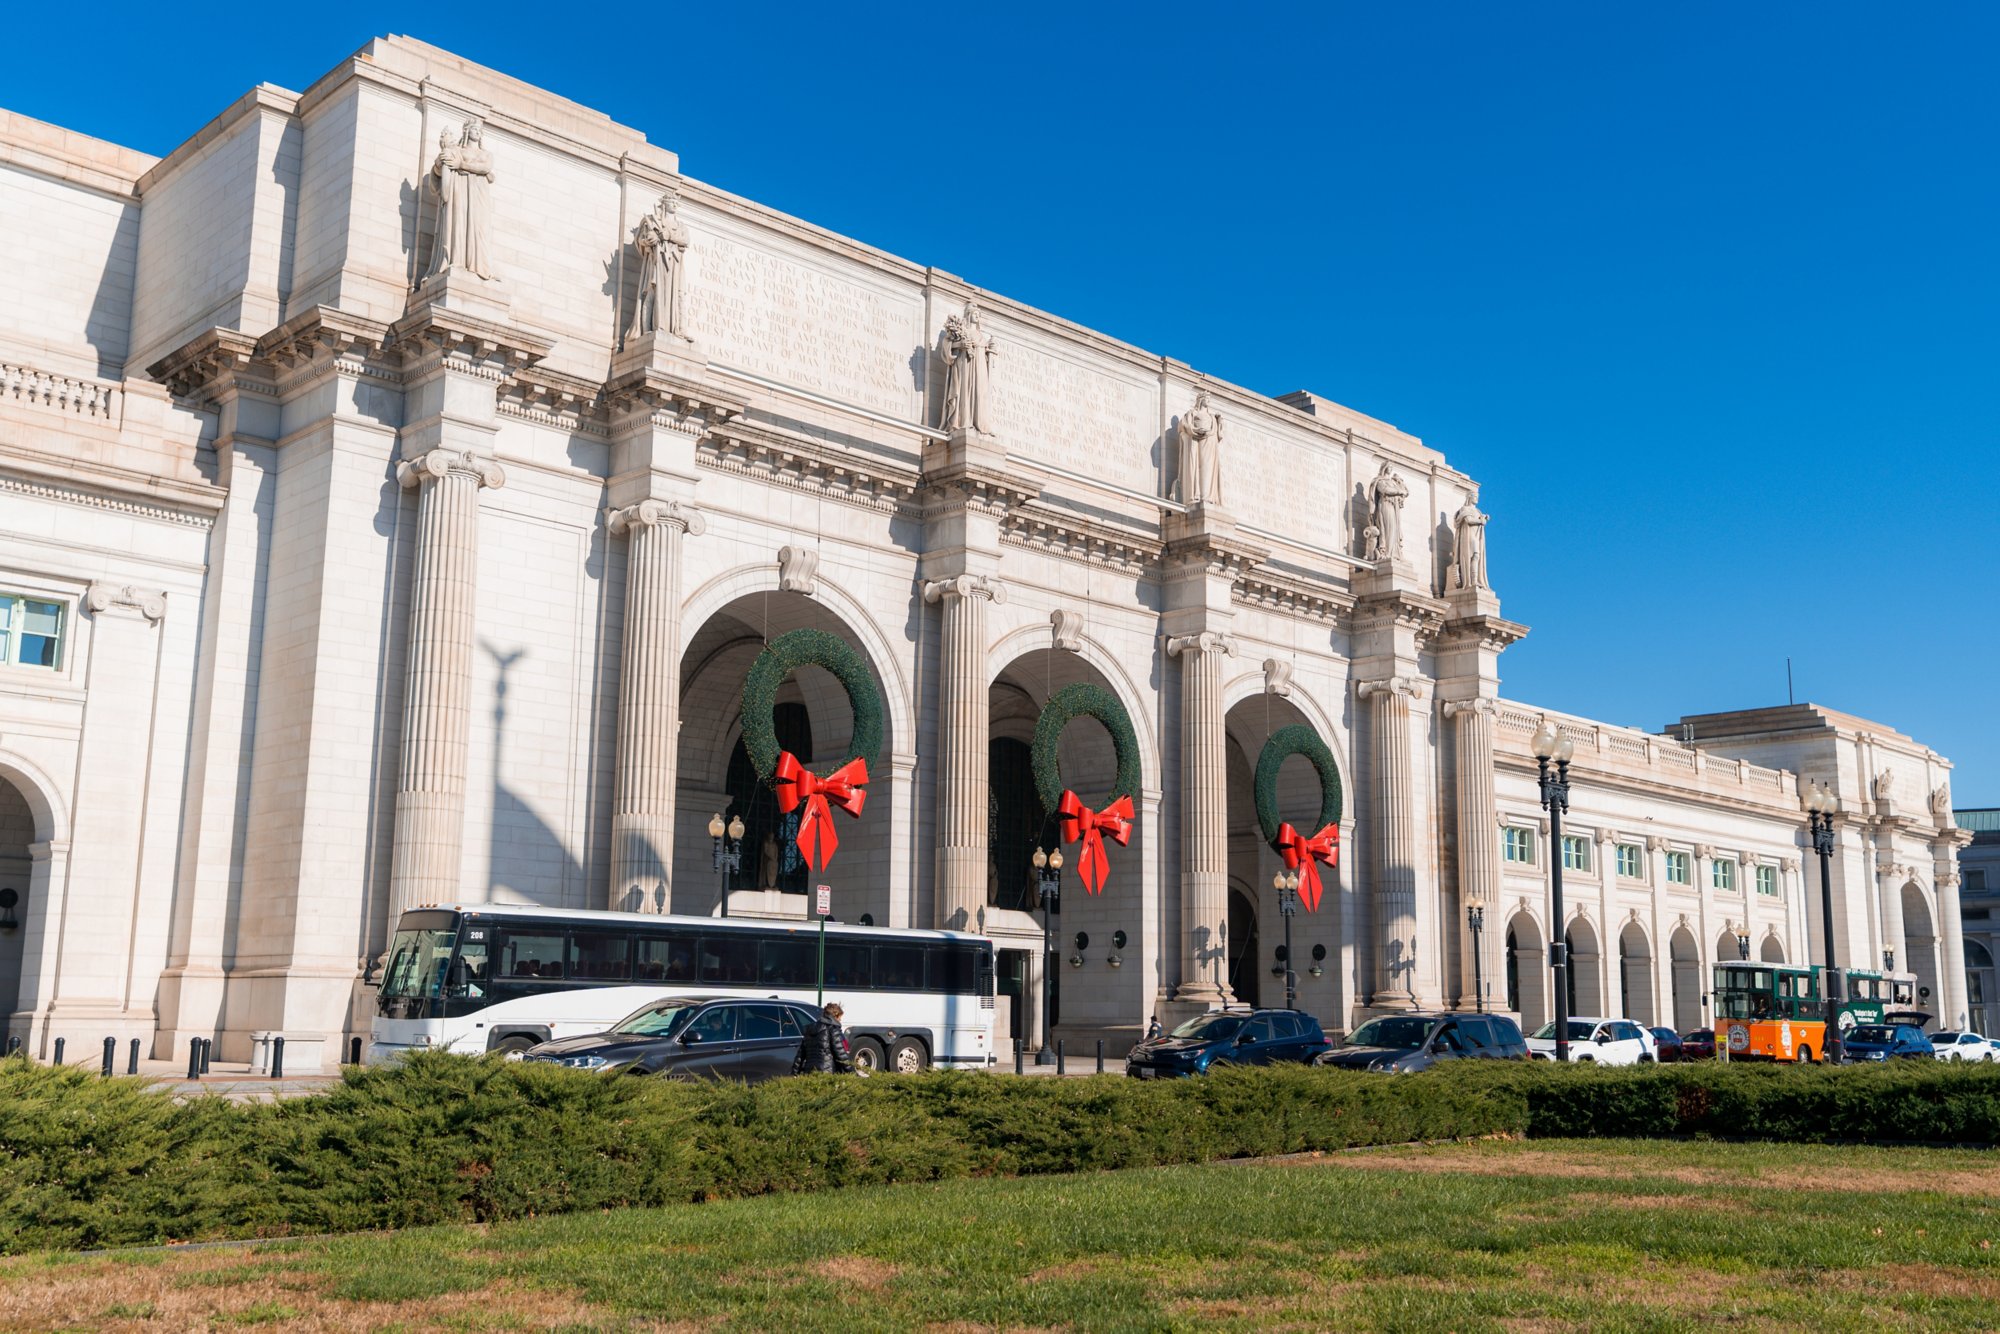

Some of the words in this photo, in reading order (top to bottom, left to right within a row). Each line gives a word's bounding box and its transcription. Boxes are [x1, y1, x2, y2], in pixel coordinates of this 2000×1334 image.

[699, 268, 737, 290] FORCES
[745, 283, 756, 296] OF
[763, 289, 800, 311] NATURE
[806, 304, 818, 317] TO
[823, 310, 837, 323] DO
[842, 316, 857, 330] HIS
[862, 323, 888, 340] WORK
[701, 257, 720, 272] USE
[728, 266, 756, 284] MANY
[763, 278, 795, 297] FOODS
[804, 292, 823, 307] AND
[828, 300, 864, 322] COMPEL
[870, 315, 888, 330] THE
[714, 239, 735, 255] FIRE
[746, 250, 796, 276] GREATEST
[801, 269, 812, 282] OF
[819, 275, 880, 305] DISCOVERIES
[734, 257, 755, 273] MAN
[762, 267, 775, 280] TO
[780, 273, 799, 289] LIVE
[805, 282, 814, 294] IN
[821, 288, 860, 310] VARIOUS
[865, 303, 910, 327] CLIMATES
[686, 282, 744, 311] LECTRICITY
[755, 305, 796, 328] CARRIER
[801, 320, 814, 333] OF
[819, 326, 845, 344] LIGHT
[851, 337, 869, 352] AND
[874, 344, 904, 363] POWER
[687, 305, 698, 318] OF
[706, 312, 743, 333] HUMAN
[751, 326, 788, 347] SPEECH
[793, 340, 817, 357] OVER
[823, 350, 849, 367] LAND
[857, 361, 874, 375] AND
[880, 368, 896, 382] SEA
[690, 295, 744, 322] DEVOURER
[750, 315, 761, 327] OF
[769, 321, 790, 337] TIME
[797, 330, 816, 345] AND
[823, 338, 850, 356] SPACE
[709, 343, 735, 361] HAST
[741, 353, 759, 368] PUT
[766, 361, 779, 375] ALL
[788, 368, 821, 388] THINGS
[828, 380, 859, 399] UNDER
[864, 391, 878, 405] HIS
[884, 397, 904, 413] FEET
[731, 331, 774, 354] SERVANT
[780, 347, 792, 359] OF
[798, 352, 818, 368] MAN
[829, 362, 860, 381] ITSELF
[863, 373, 907, 396] UNKNOWN
[470, 931, 484, 940] 208
